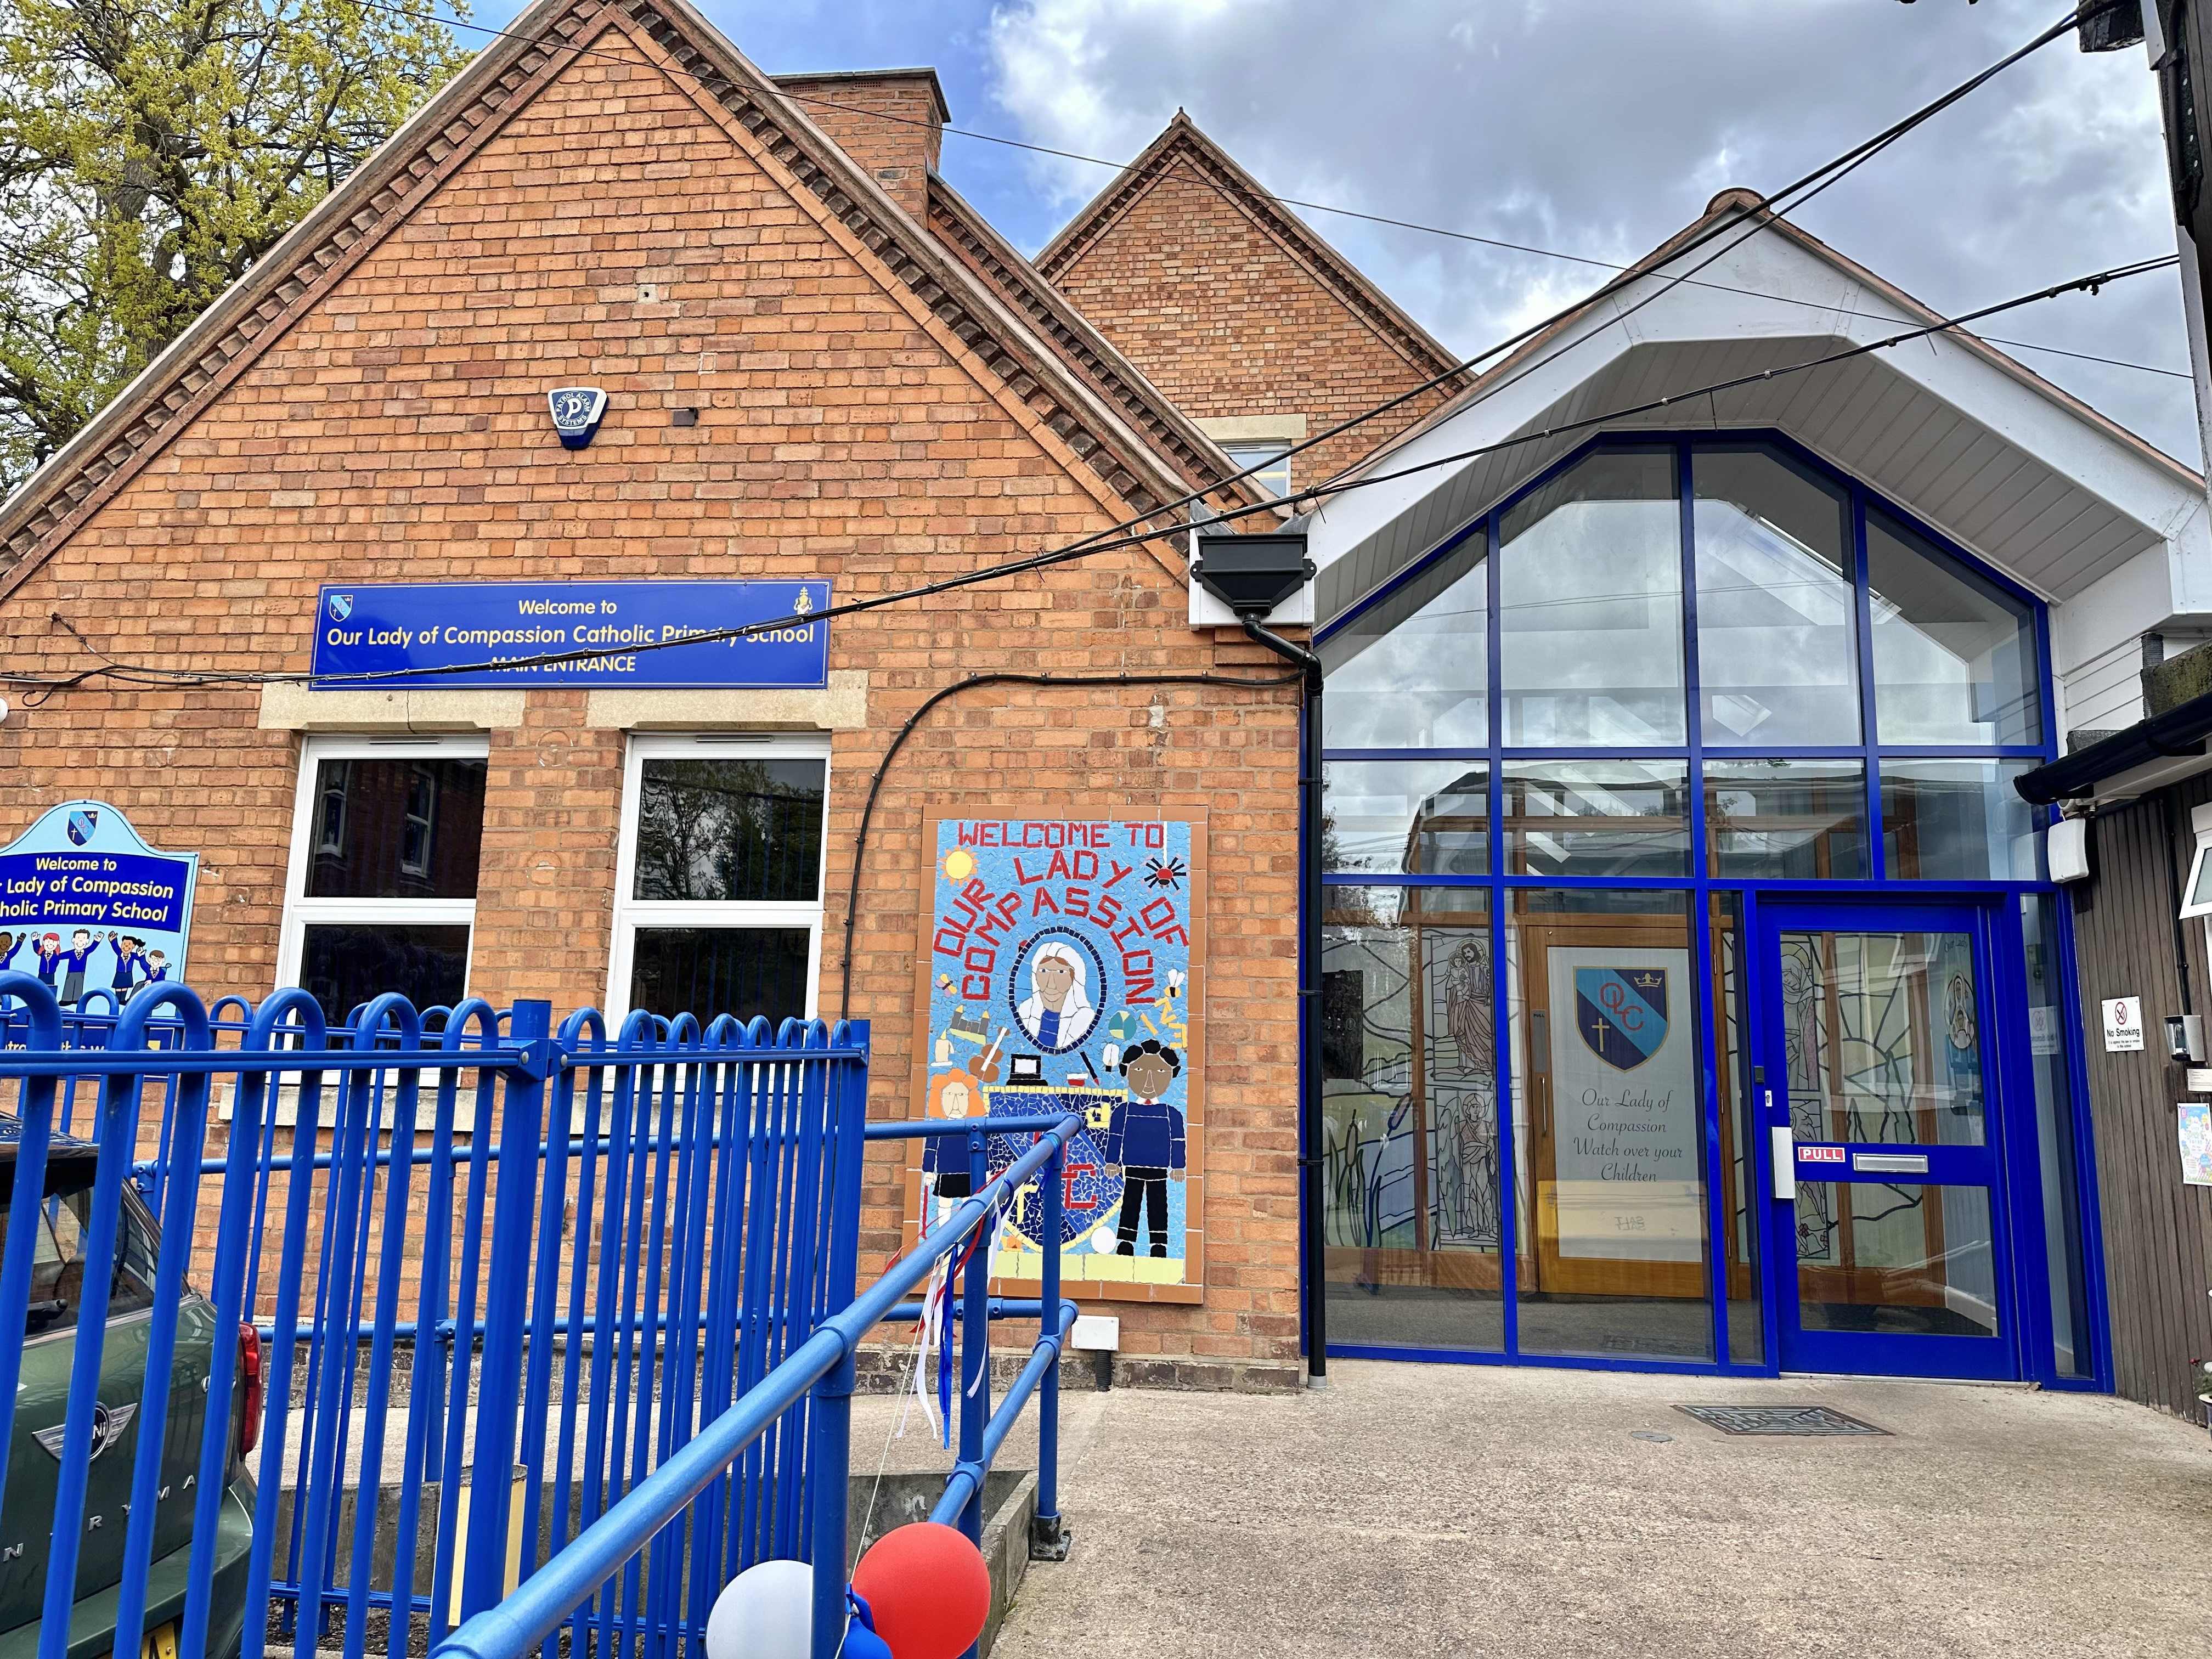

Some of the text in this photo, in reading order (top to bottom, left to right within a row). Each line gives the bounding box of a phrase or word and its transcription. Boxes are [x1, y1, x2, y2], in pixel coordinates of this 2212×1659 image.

[556, 393, 590, 412] PATROL ALARM
[558, 415, 587, 426] SYSTEMS
[518, 599, 617, 614] Welcome to
[328, 628, 363, 645] Our
[368, 626, 413, 649] Lady
[419, 625, 439, 644] of
[444, 625, 565, 648] Compassion
[573, 624, 654, 643] Catholic
[958, 822, 1164, 848] WELCOME TO
[36, 856, 117, 871] Welcome to
[7, 876, 174, 899] Lady of Compassion
[0, 899, 168, 922] holic Primary School
[933, 850, 1189, 957] OUR LADY OF
[962, 887, 1155, 1004] COMPASSION
[2107, 1027, 2140, 1037] No Smoking
[1582, 1088, 1674, 1113] Our Lady of
[1588, 1113, 1666, 1136] Compassion
[1573, 1137, 1683, 1162] Watch over your
[1803, 1149, 1841, 1160] PULL
[1601, 1163, 1657, 1182] Children
